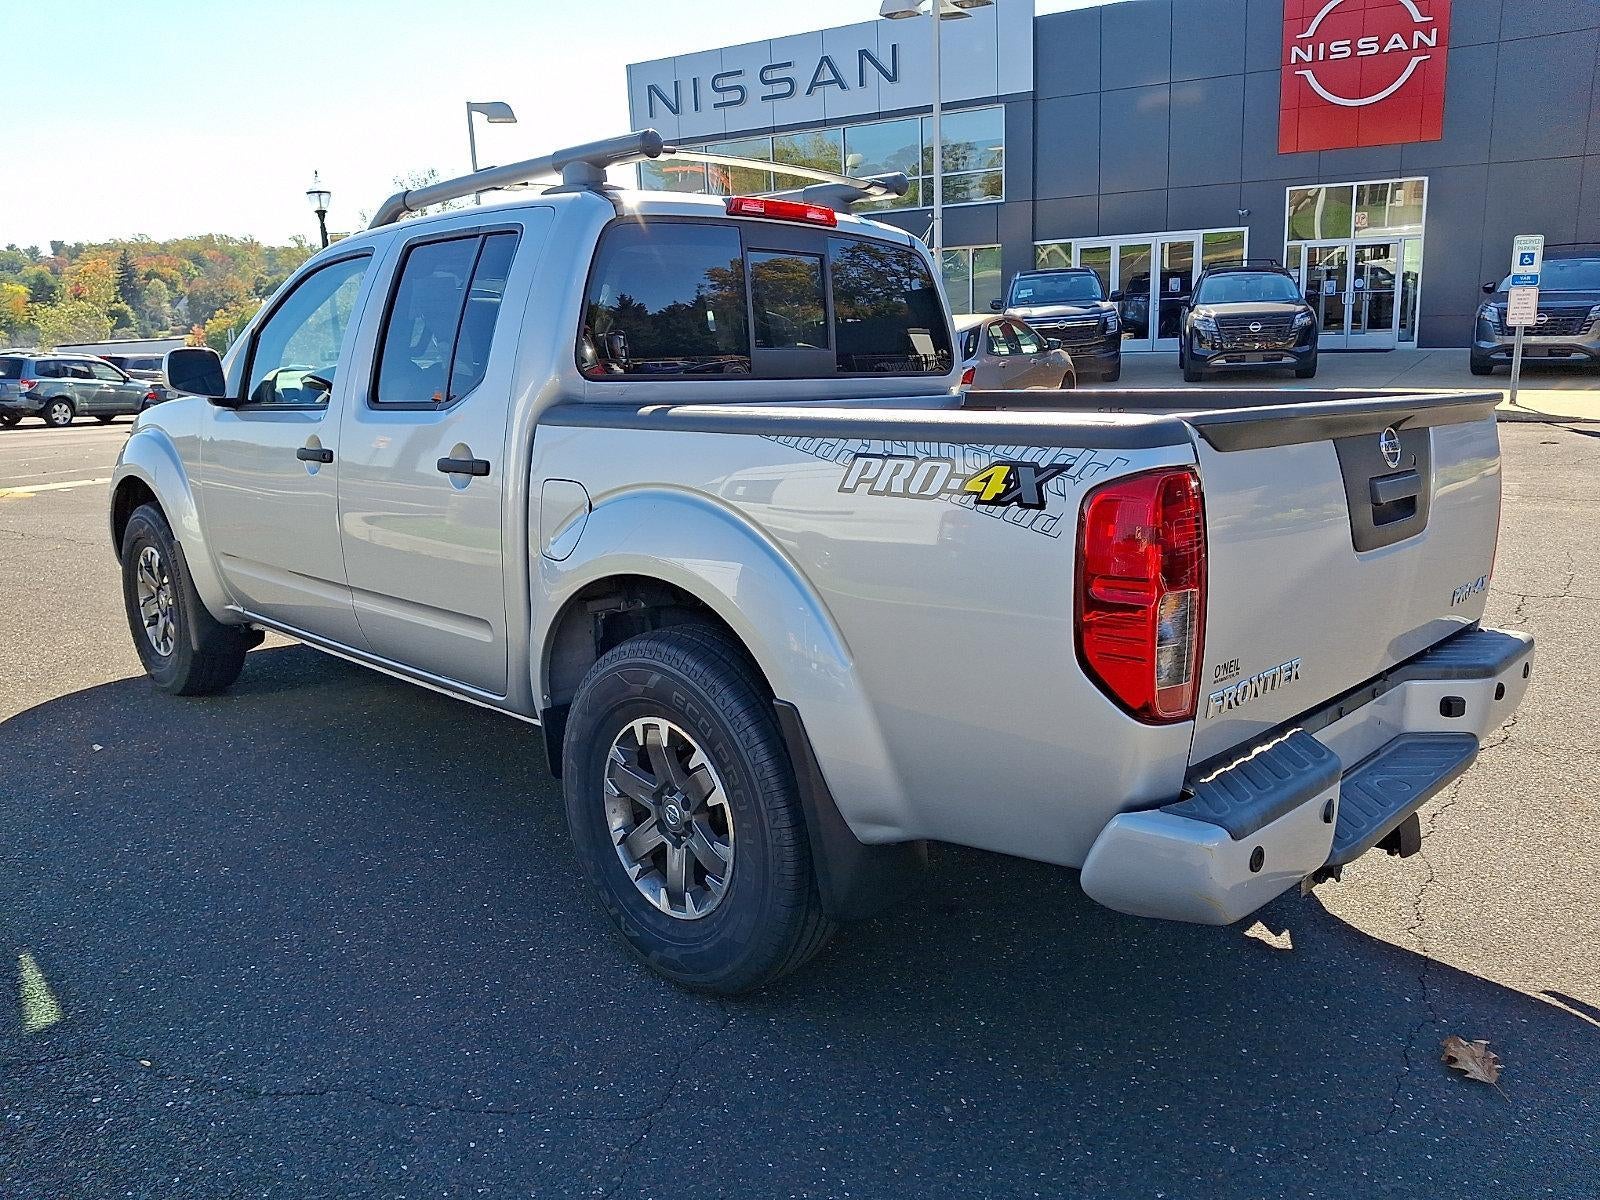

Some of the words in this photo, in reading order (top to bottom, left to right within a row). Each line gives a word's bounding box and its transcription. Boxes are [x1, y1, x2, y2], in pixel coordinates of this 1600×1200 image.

[1290, 27, 1438, 65] NISSAN
[646, 42, 900, 119] NISSAN
[838, 453, 1075, 510] PRO-4X
[1205, 657, 1302, 719] FRONTIER
[1214, 657, 1241, 679] O'NEIL
